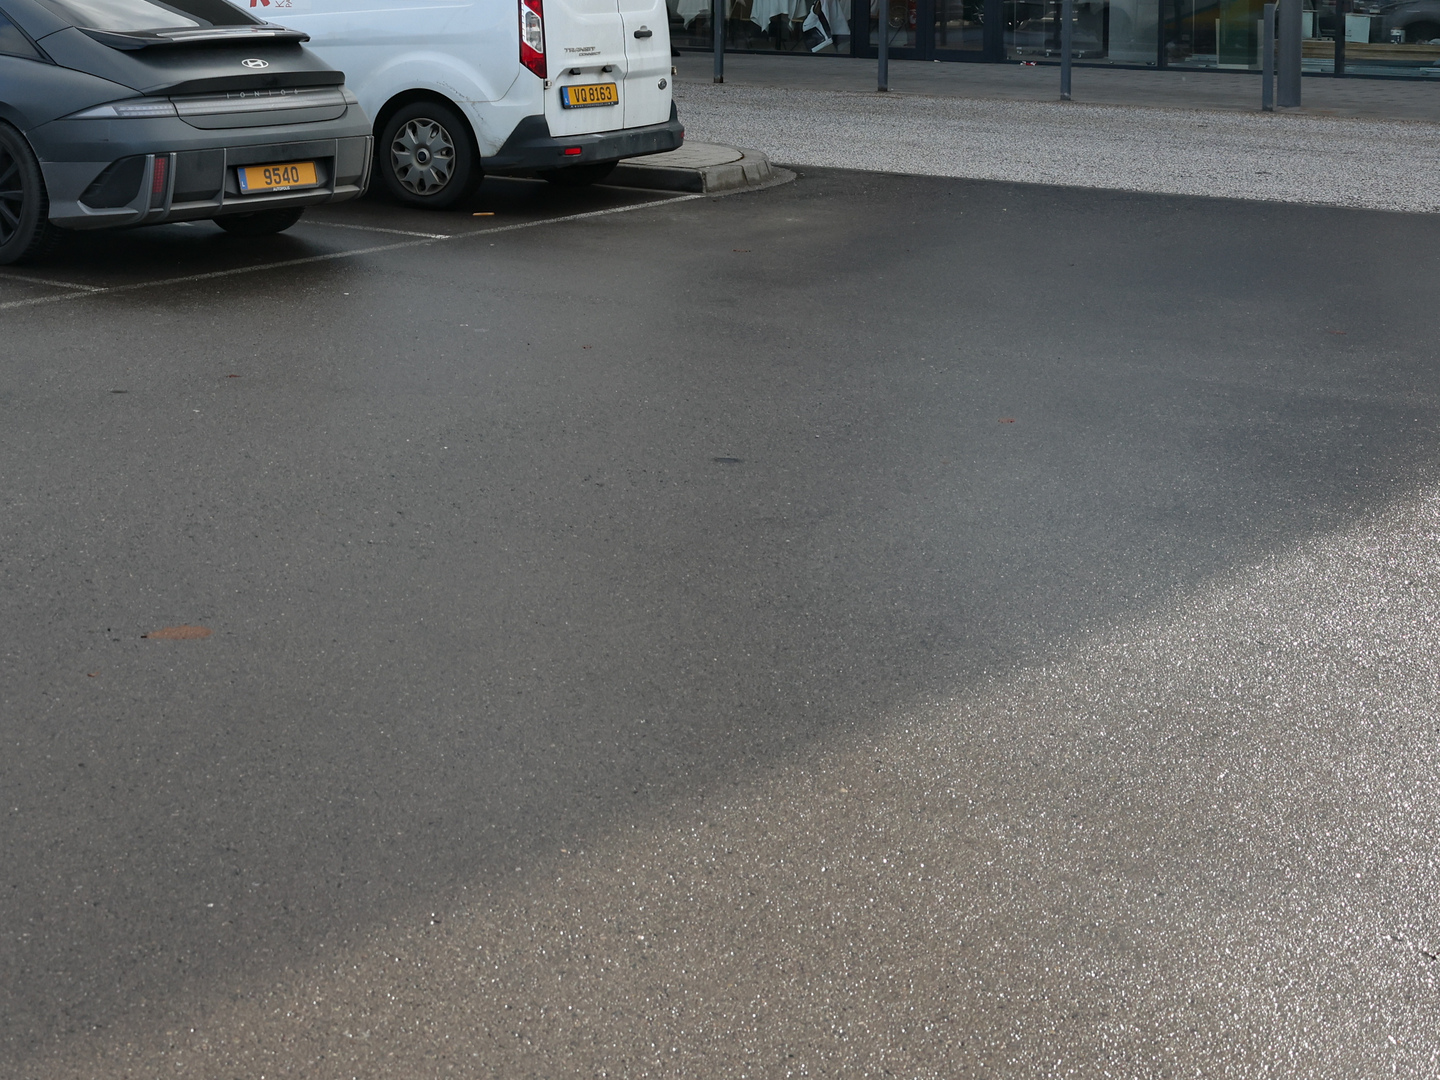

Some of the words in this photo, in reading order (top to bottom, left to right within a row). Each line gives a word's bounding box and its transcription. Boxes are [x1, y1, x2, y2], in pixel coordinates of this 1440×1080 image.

[574, 88, 587, 103] VQ
[589, 86, 612, 101] 8163
[263, 166, 300, 185] 9540
